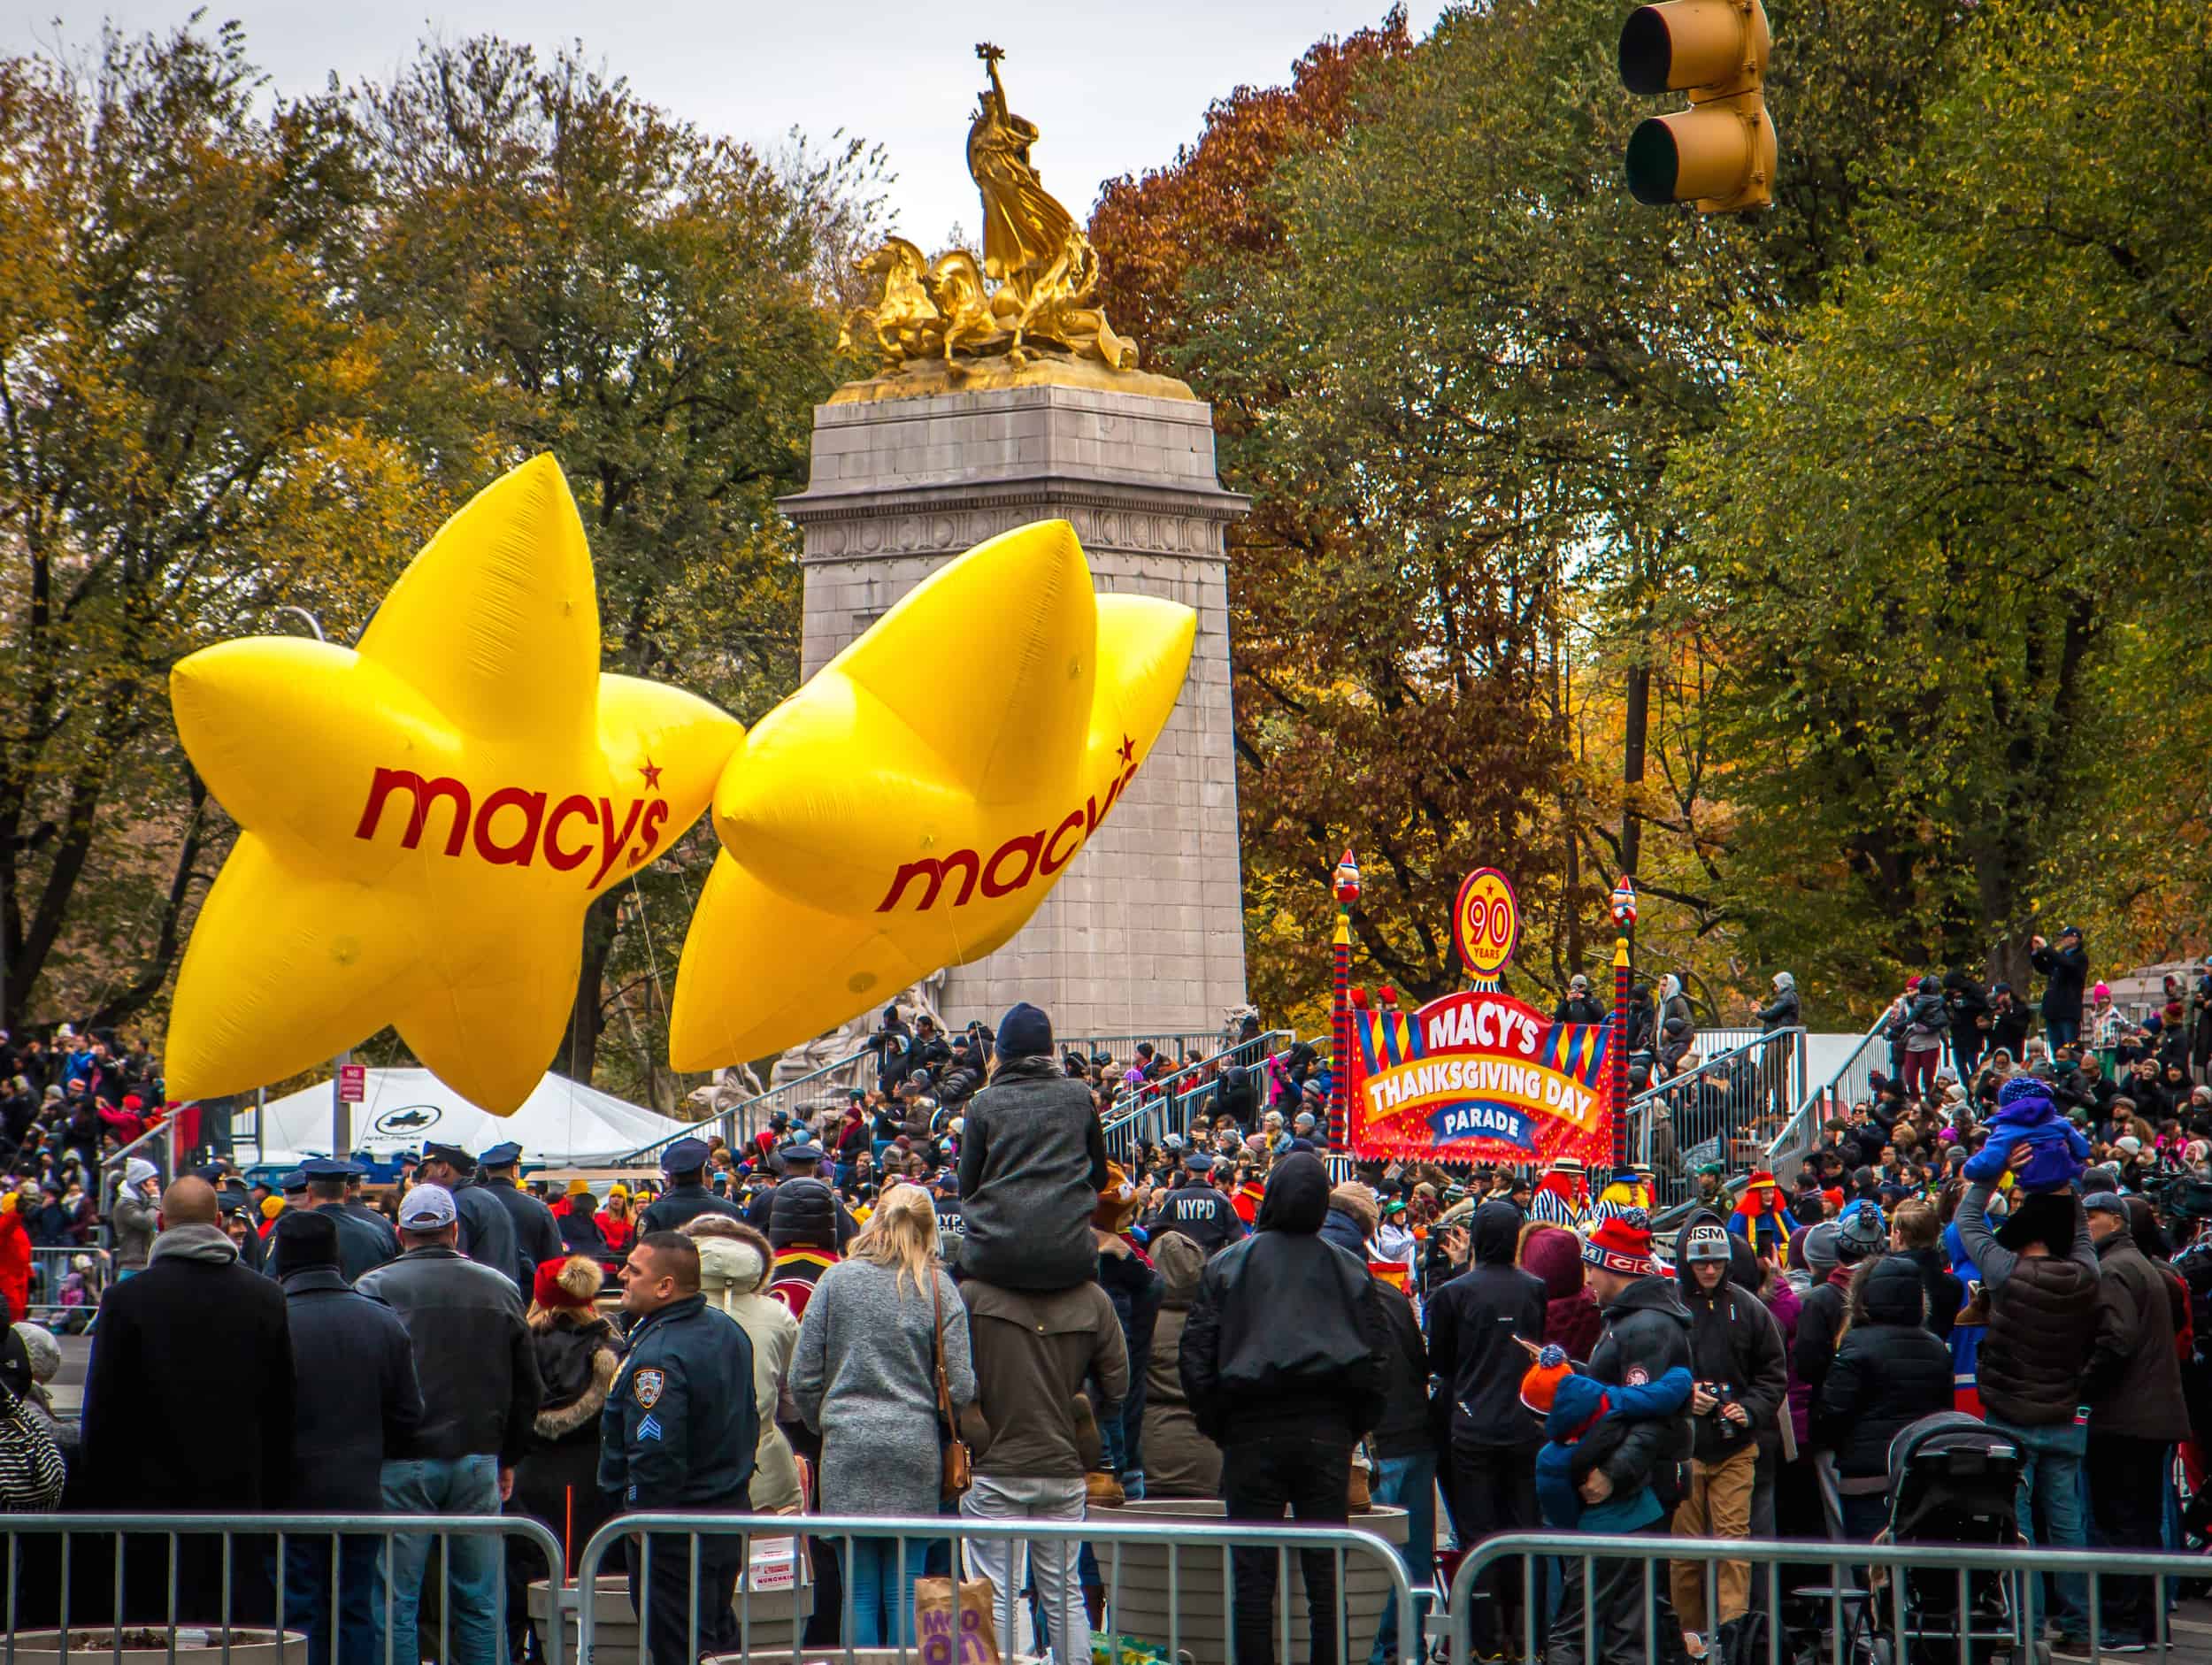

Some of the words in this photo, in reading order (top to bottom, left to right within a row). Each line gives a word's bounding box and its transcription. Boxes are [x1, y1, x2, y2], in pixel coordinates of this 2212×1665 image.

[1467, 894, 1511, 949] 90
[1473, 947, 1501, 960] YEARS
[1428, 1001, 1540, 1055] MACY'S
[1369, 1059, 1542, 1113] THANKSGIVING
[1545, 1075, 1592, 1121] DAY
[1443, 1108, 1520, 1139] PARADE
[1177, 1198, 1216, 1220] NYPD
[1691, 1227, 1724, 1239] ISM
